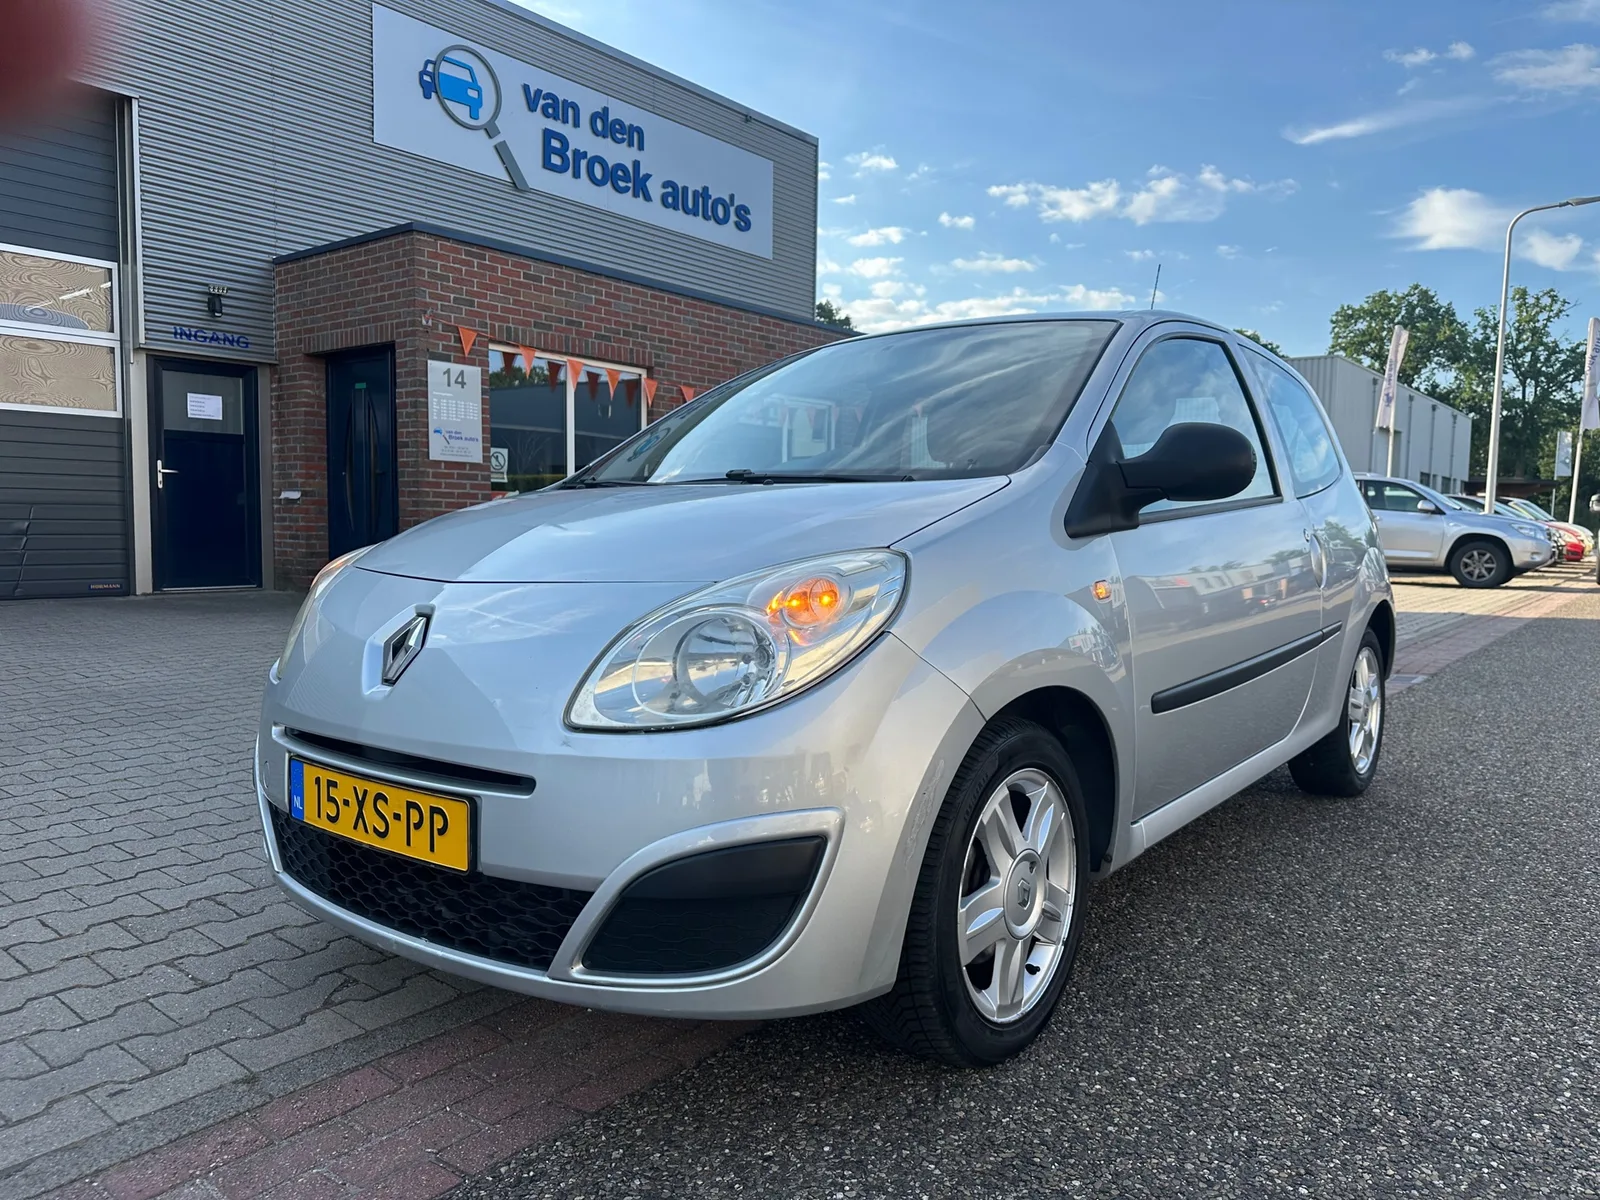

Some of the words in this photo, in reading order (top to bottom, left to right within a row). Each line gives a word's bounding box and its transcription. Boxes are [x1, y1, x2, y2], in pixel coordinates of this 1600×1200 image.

[522, 82, 581, 129] van
[589, 105, 645, 152] den
[542, 127, 654, 203] Broek
[660, 178, 752, 233] auto's
[173, 326, 250, 349] INGANG
[443, 367, 467, 389] 14
[293, 795, 303, 810] NL
[314, 776, 449, 853] 15-XS-PP
